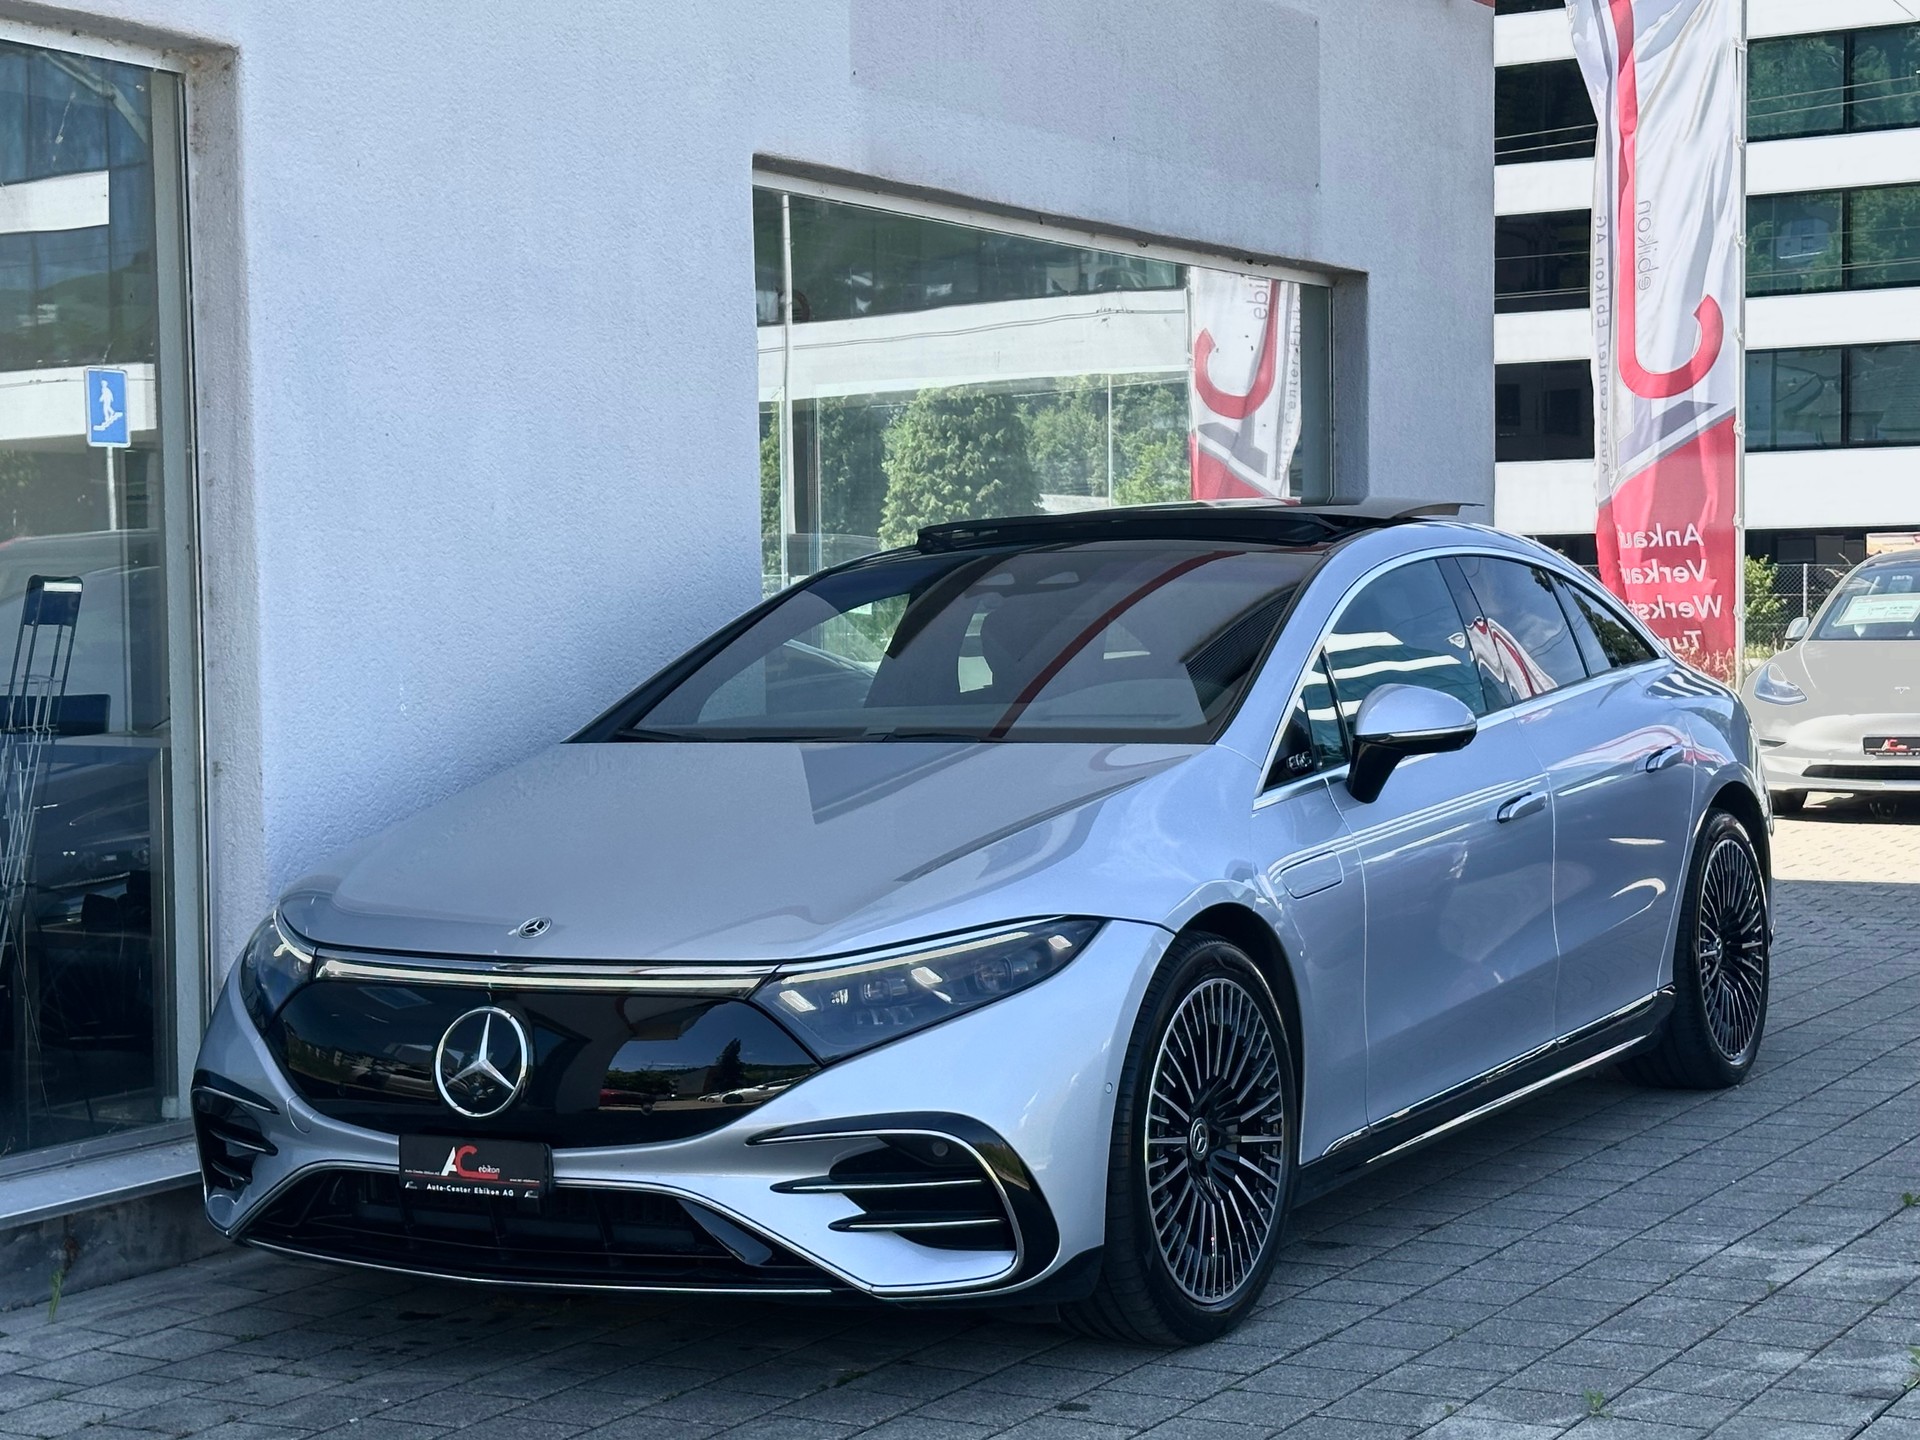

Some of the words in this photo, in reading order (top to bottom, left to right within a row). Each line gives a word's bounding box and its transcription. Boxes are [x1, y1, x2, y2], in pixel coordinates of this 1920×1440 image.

[478, 1164, 500, 1174] ebikon
[426, 1183, 471, 1193] Auto-Center
[473, 1187, 500, 1196] Ebikon
[502, 1189, 514, 1197] AG
